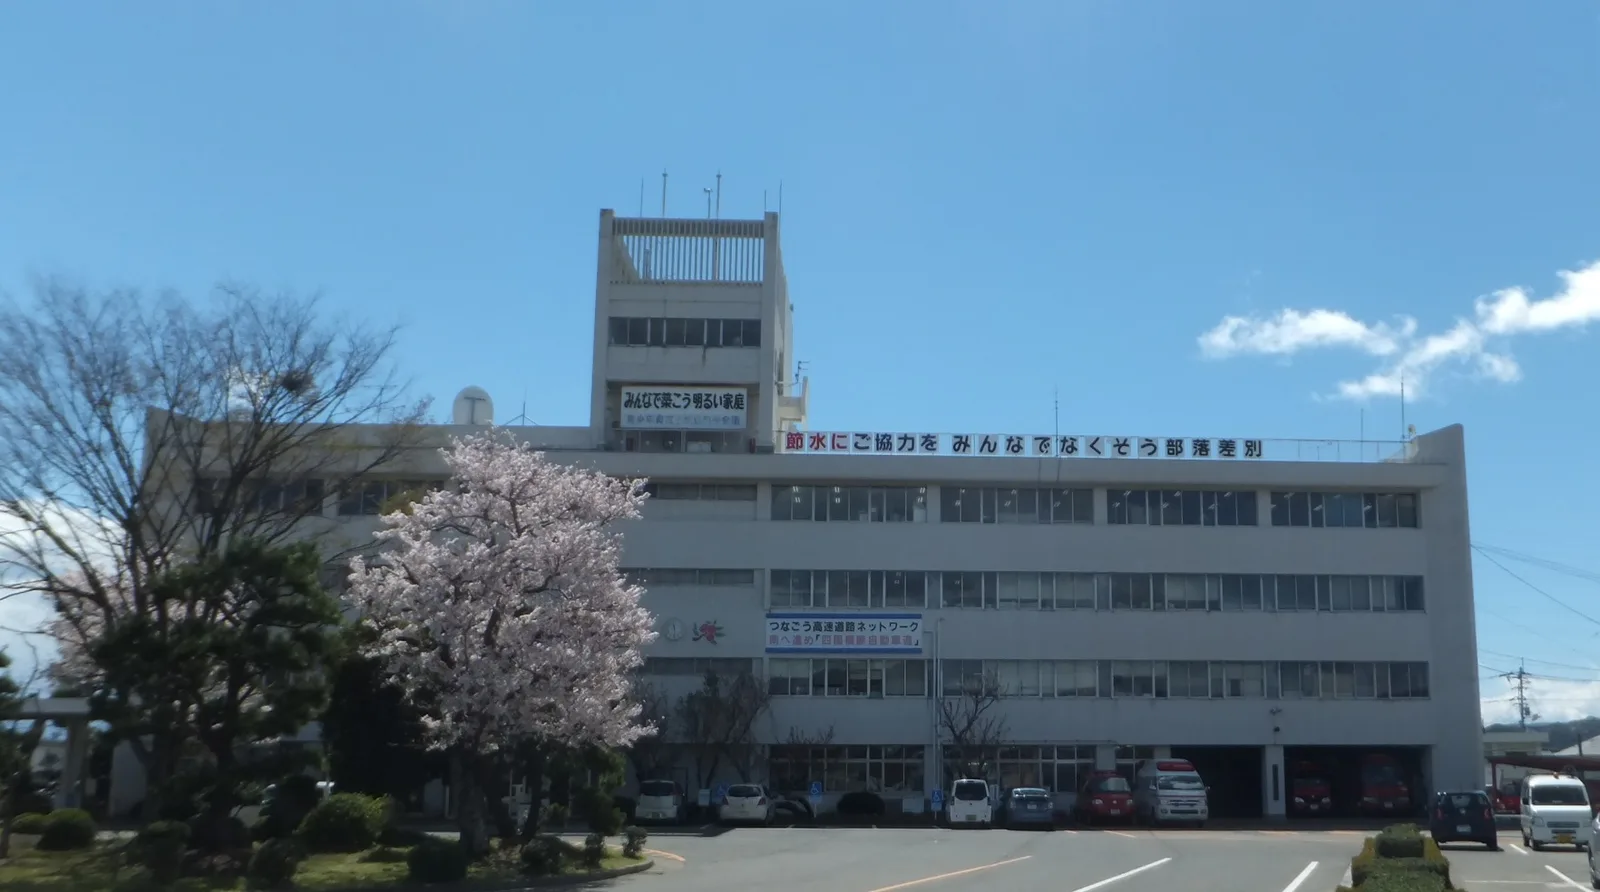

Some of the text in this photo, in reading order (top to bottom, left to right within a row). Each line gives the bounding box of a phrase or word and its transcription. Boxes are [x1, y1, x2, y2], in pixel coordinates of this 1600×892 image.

[786, 431, 1262, 457] 節水にご協力を みんなでなくそう部落差別
[769, 621, 919, 632] つなごう高速道路ネットワーク
